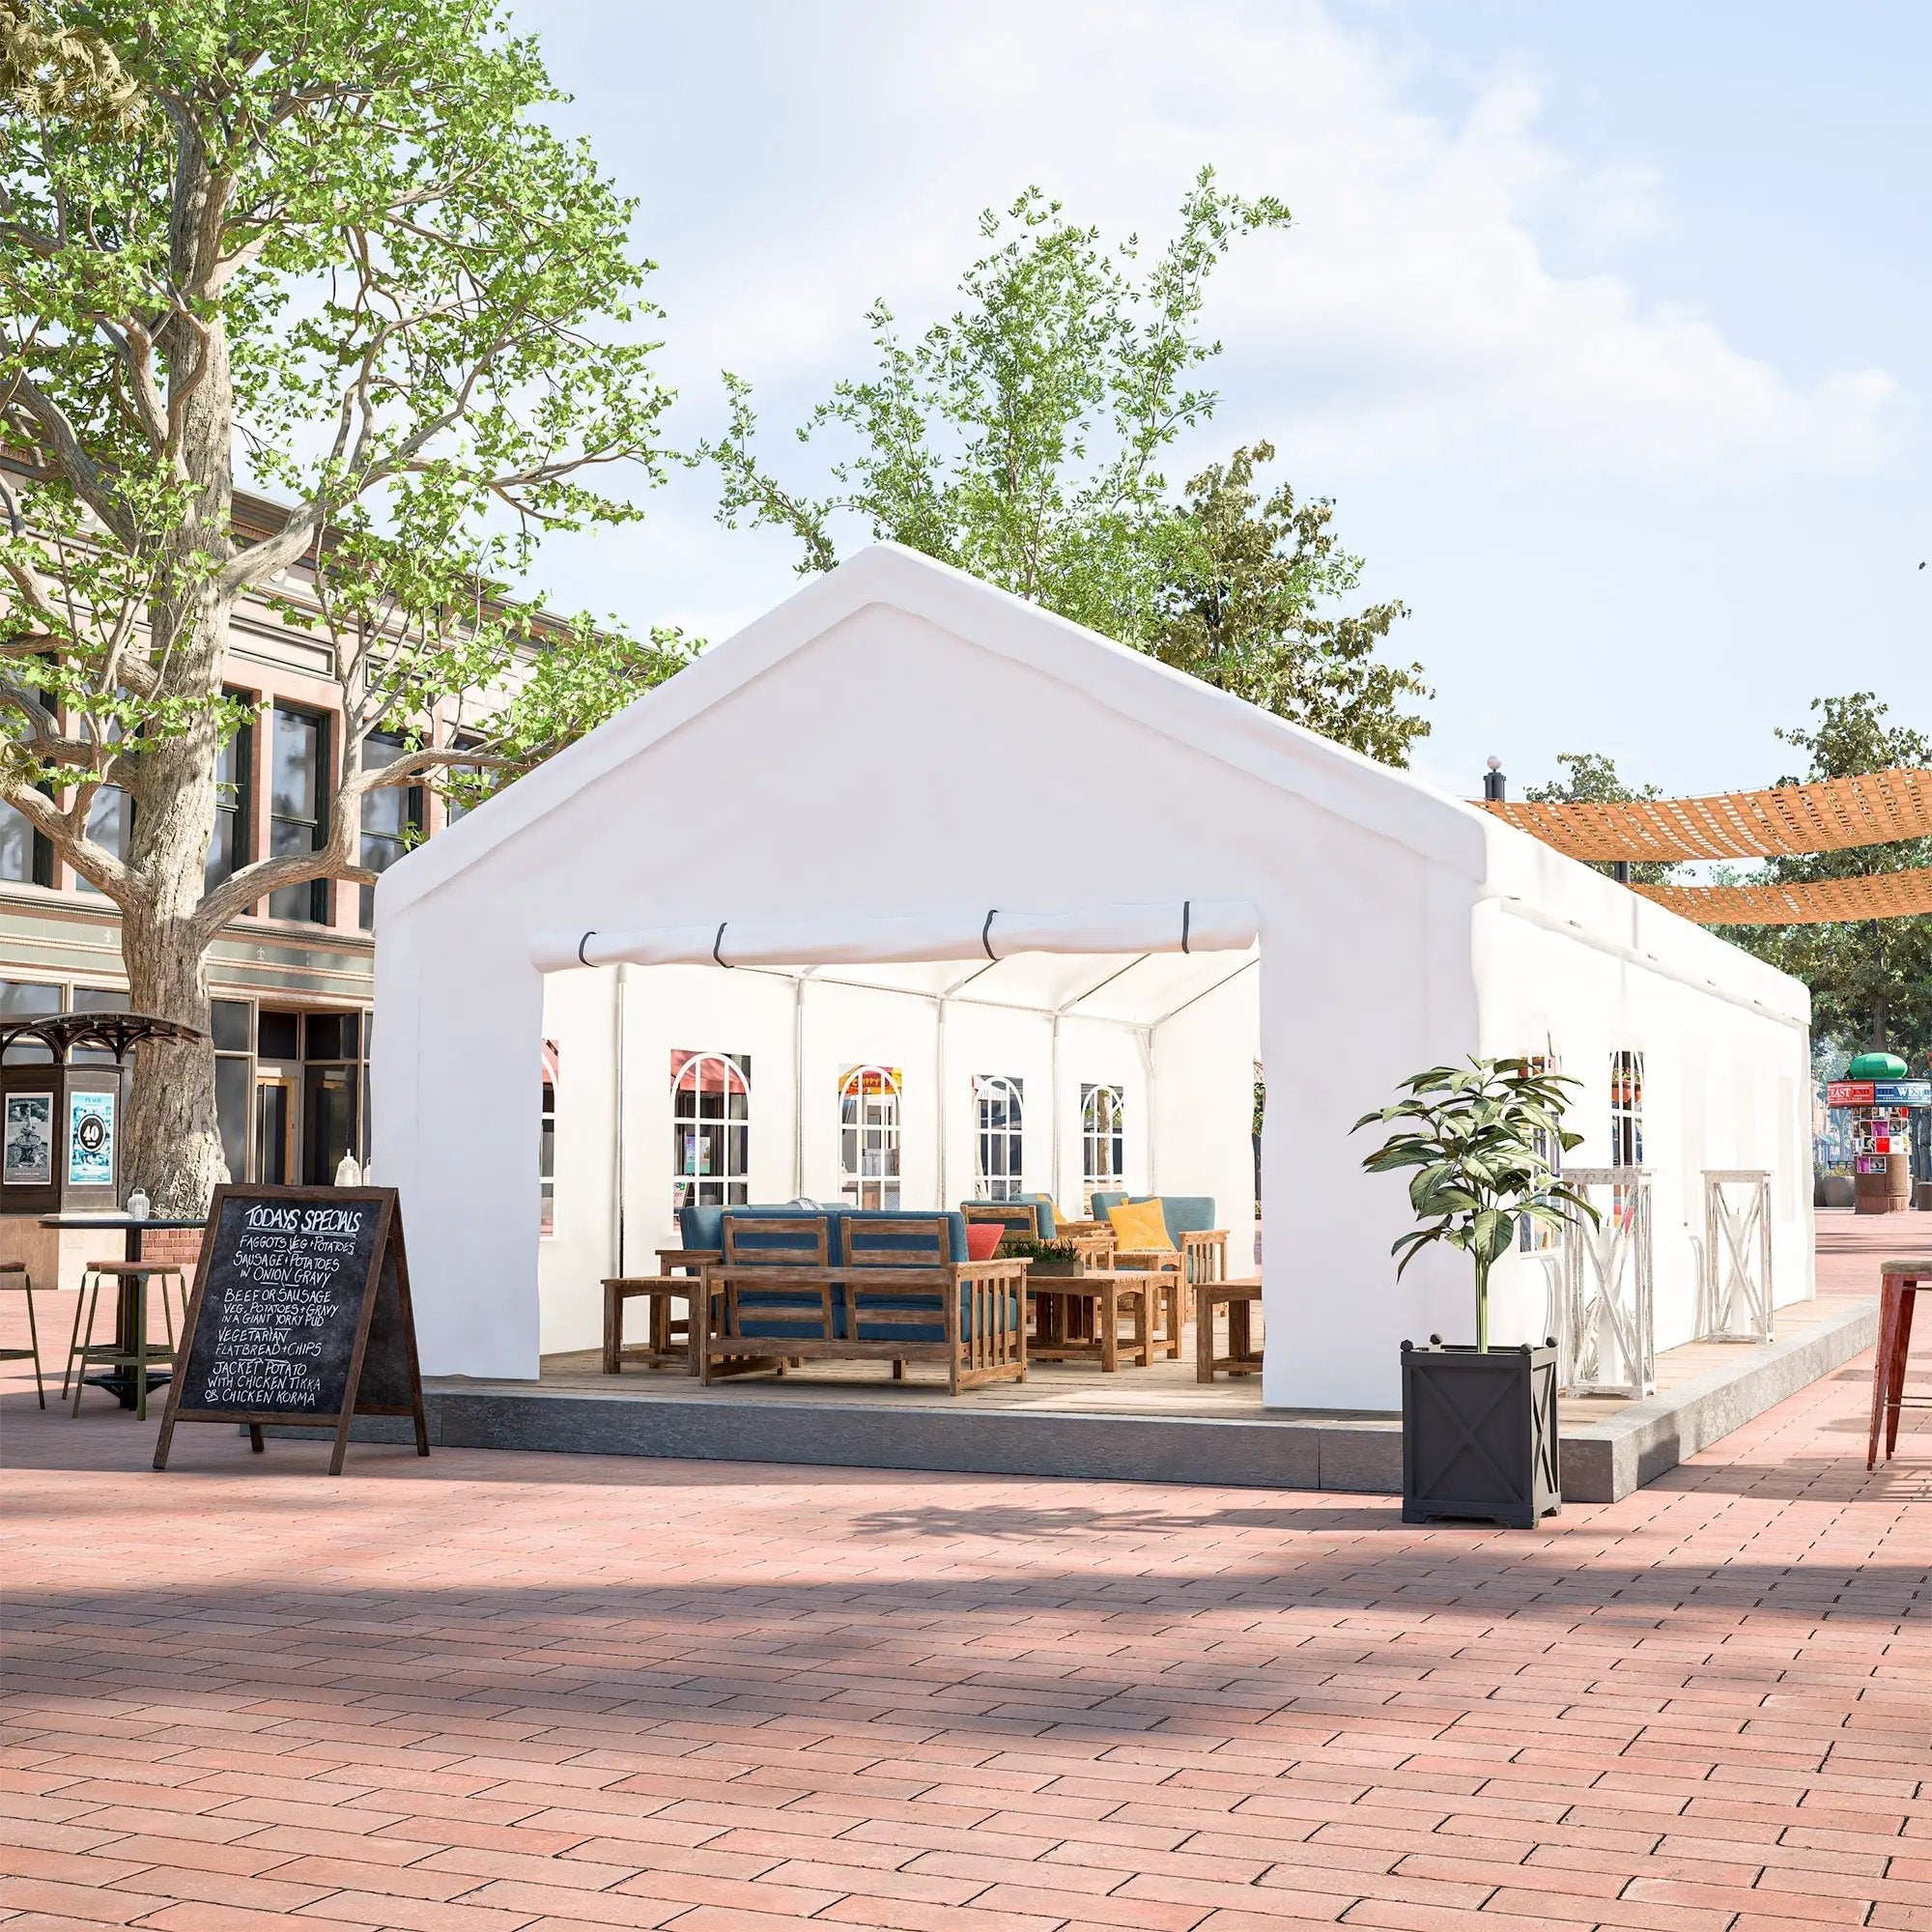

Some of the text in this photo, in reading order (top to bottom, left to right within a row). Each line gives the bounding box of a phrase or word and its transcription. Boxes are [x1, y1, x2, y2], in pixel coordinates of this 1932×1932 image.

[1831, 1087, 1852, 1097] EAST
[1896, 1087, 1924, 1096] WEST
[82, 1124, 99, 1141] 40
[244, 1205, 363, 1233] TODAYS SPECIALS
[239, 1235, 288, 1251] FAGGOTS
[289, 1235, 308, 1251] VEG
[233, 1251, 284, 1267] SAUSAGE
[253, 1266, 293, 1281] ONION
[294, 1268, 332, 1288] GRAVY
[223, 1288, 331, 1304] BEEF OR SAUSAGE
[249, 1301, 299, 1315] POTATOES
[305, 1303, 339, 1318] GRAVY
[242, 1313, 272, 1324] GIANT
[274, 1314, 304, 1325] YORKY
[304, 1314, 325, 1327] PUD
[217, 1326, 289, 1344] VEGETARIAN
[213, 1360, 307, 1378] JACKET POTATO
[208, 1375, 321, 1392] WITH CHICKEN TIKKA
[204, 1387, 316, 1406] OR CHICKEN KORMA
